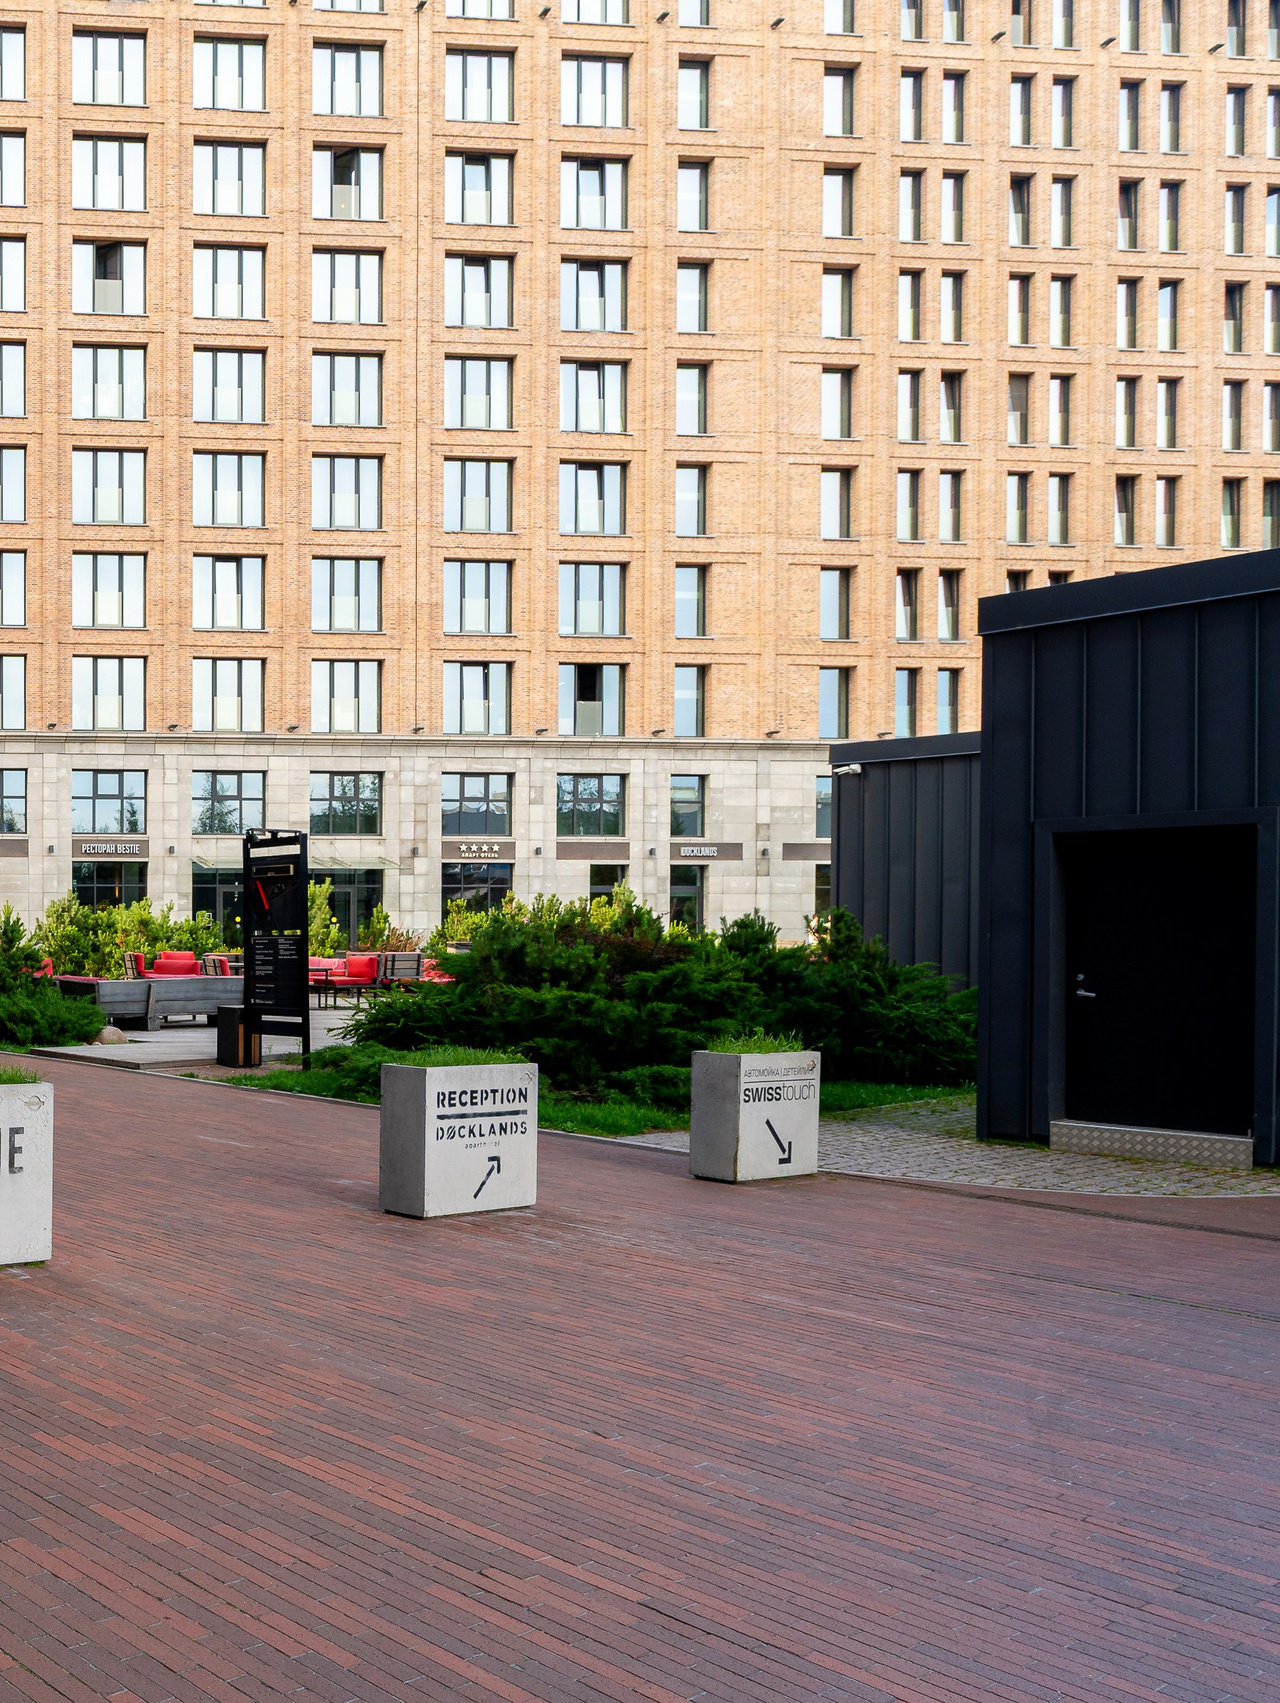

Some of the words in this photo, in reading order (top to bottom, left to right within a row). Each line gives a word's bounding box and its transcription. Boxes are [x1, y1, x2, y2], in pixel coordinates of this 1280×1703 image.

[81, 843, 116, 854] РЕСТОРАН
[117, 843, 140, 854] BESTIE
[744, 1067, 780, 1078] АВТОМОЙКА
[436, 1087, 528, 1108] RECEPTION
[743, 1081, 816, 1103] SWISStouch
